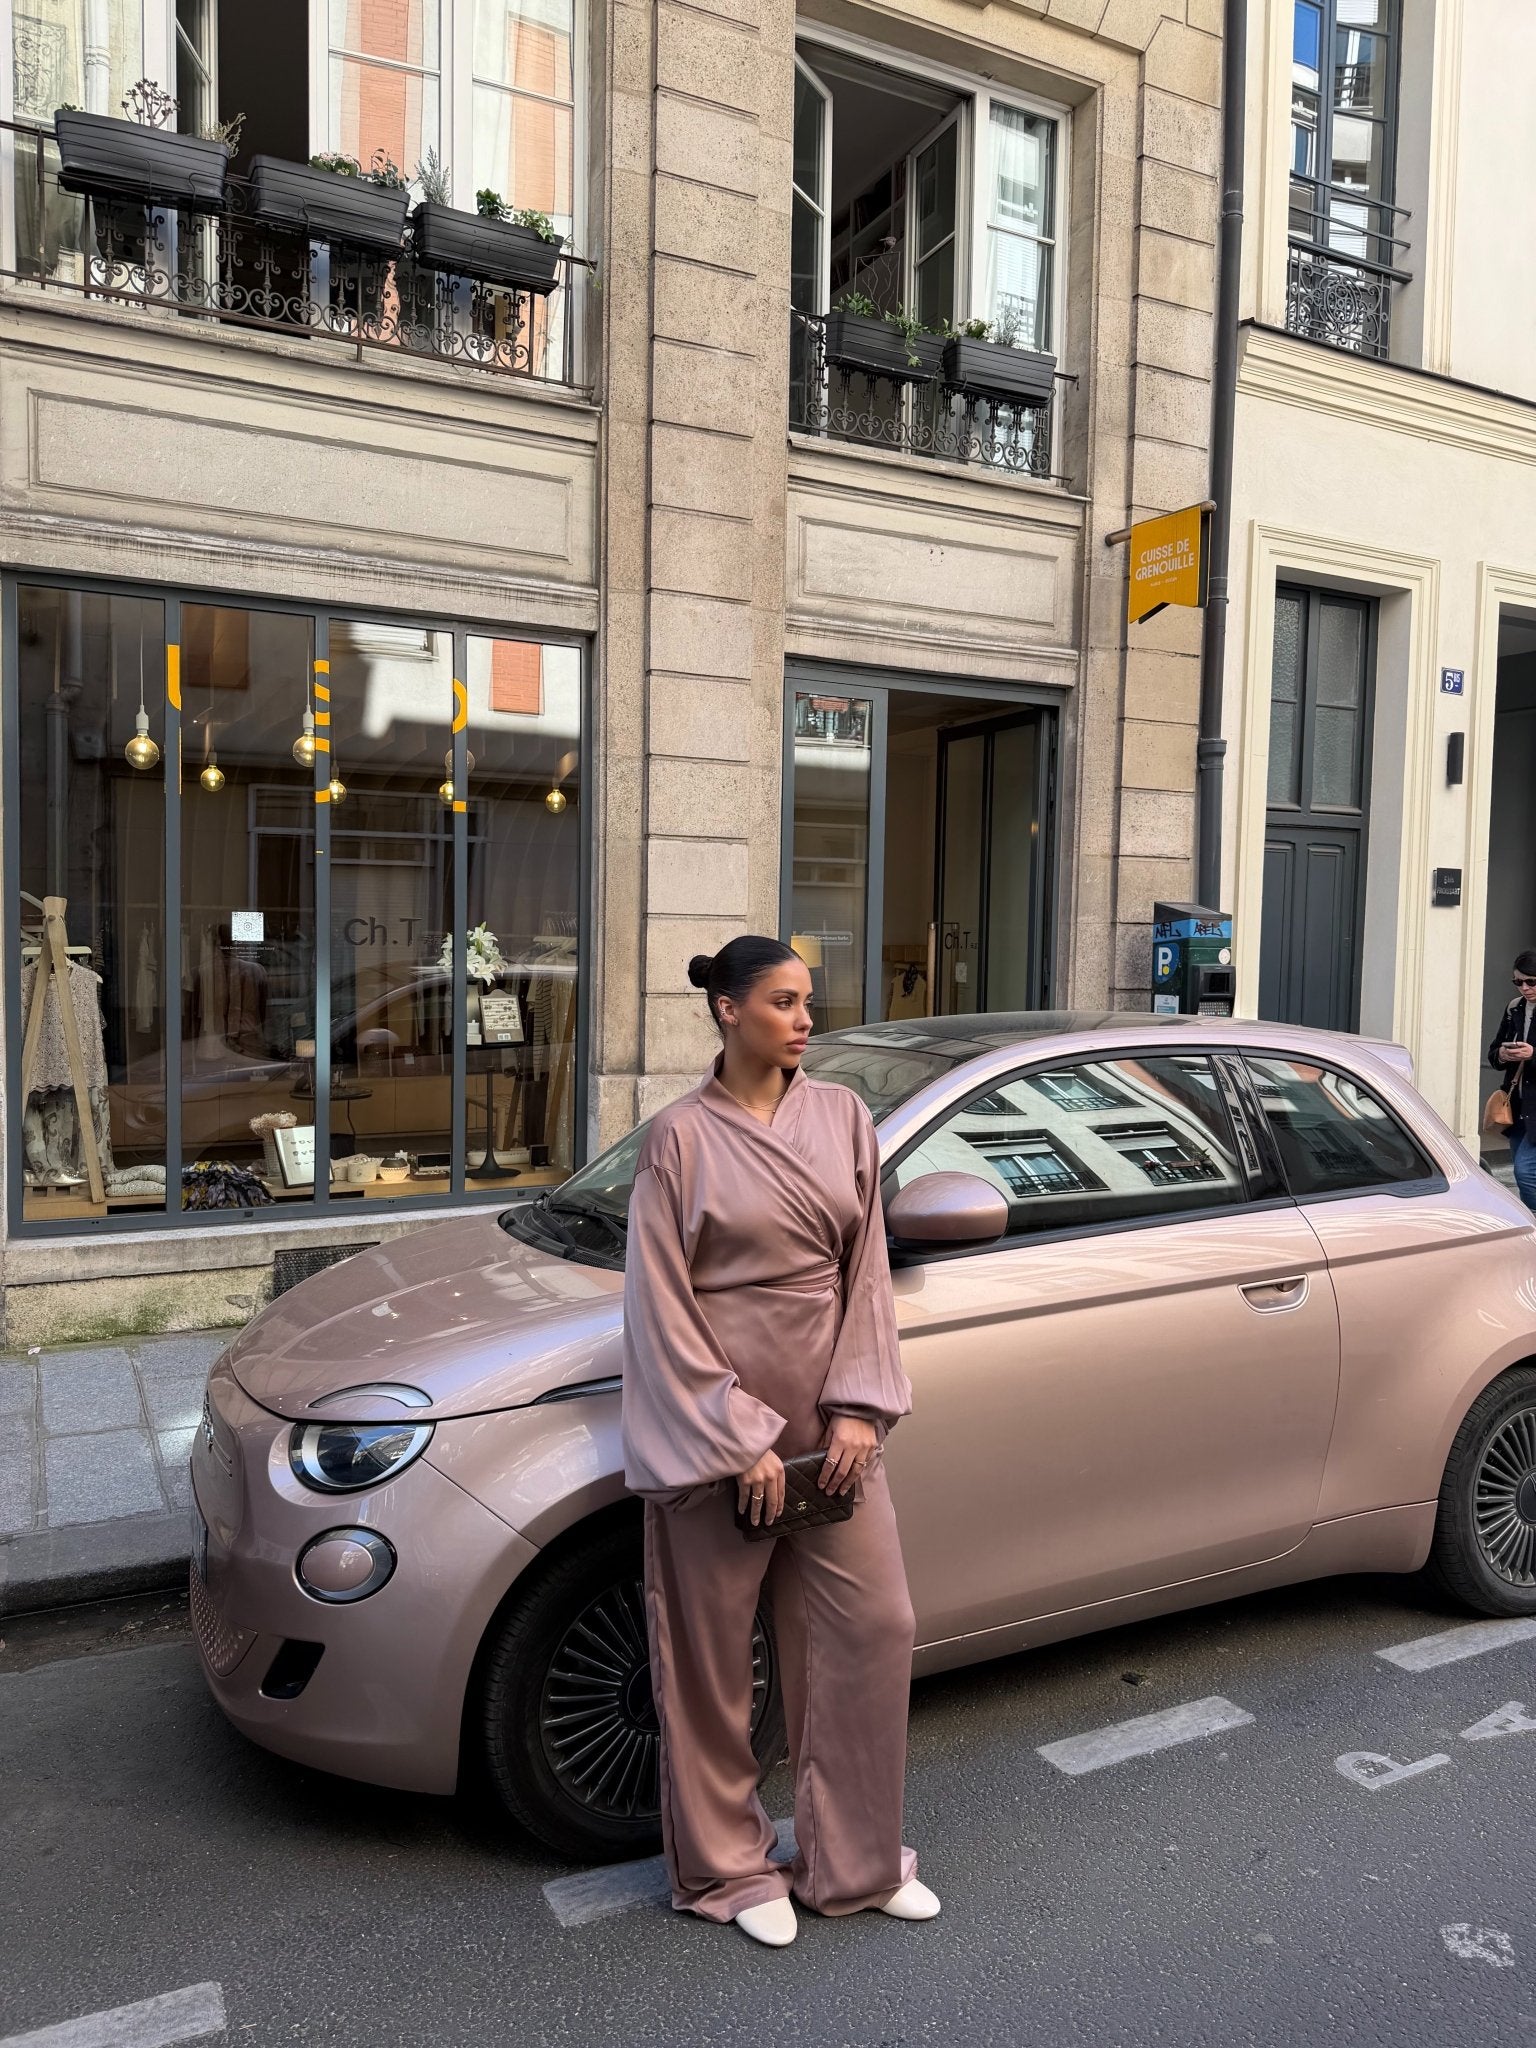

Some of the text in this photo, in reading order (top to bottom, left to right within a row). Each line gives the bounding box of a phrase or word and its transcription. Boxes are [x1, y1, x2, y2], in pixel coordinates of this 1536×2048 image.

[1140, 538, 1190, 564] CUISSE DE
[1135, 553, 1194, 580] GRENOUILLE
[1445, 672, 1453, 690] 5
[343, 916, 423, 947] Ch.T
[1158, 946, 1172, 975] P
